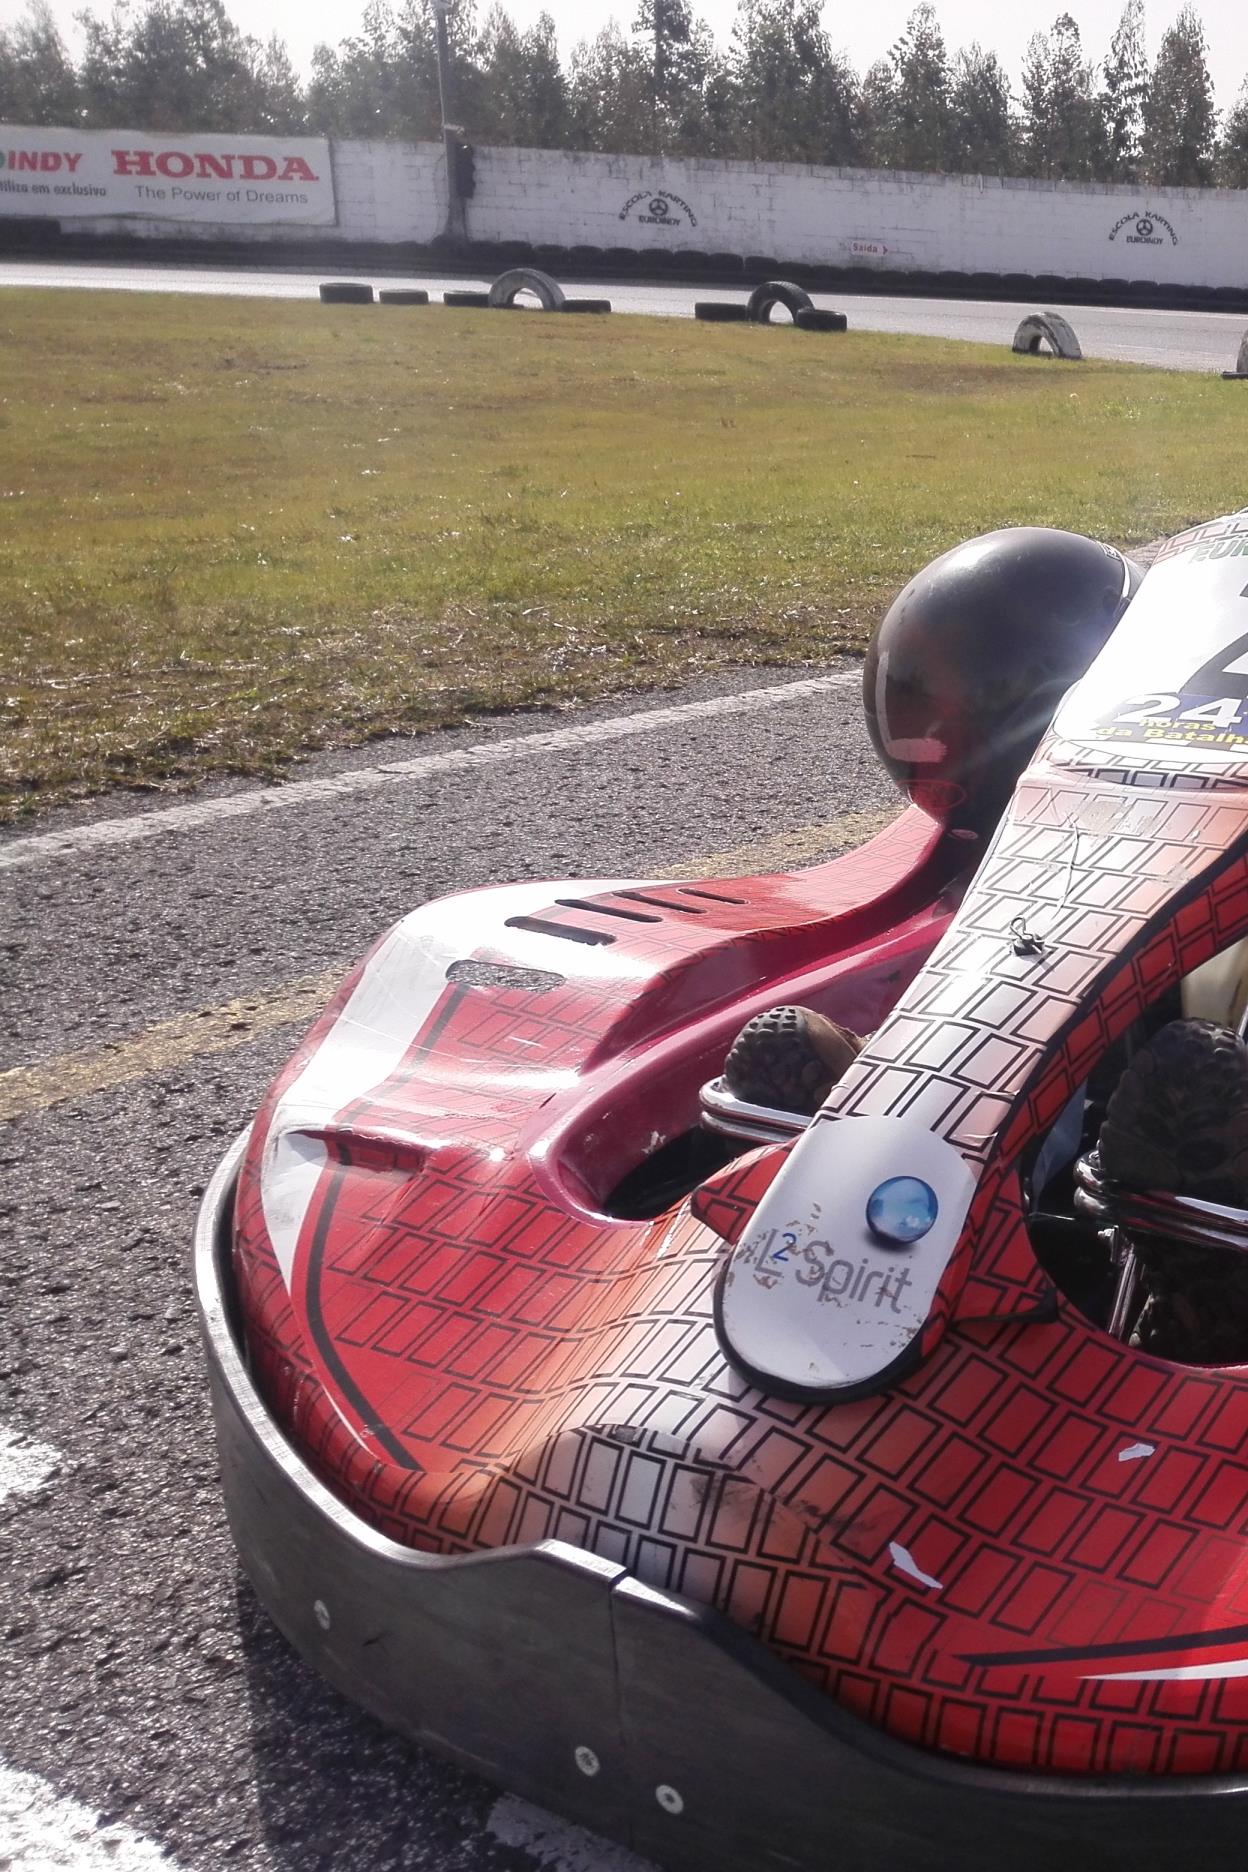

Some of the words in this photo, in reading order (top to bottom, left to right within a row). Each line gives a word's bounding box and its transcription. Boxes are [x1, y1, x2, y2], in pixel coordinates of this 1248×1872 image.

[0, 150, 83, 172] INDY
[111, 150, 319, 182] HONDA
[32, 184, 50, 194] em
[53, 182, 107, 197] exclusivo
[135, 185, 166, 200] The
[172, 188, 220, 202] Power
[226, 189, 241, 202] of
[246, 190, 309, 204] Dreams
[619, 190, 652, 220] ESCOLA
[658, 190, 698, 227] KARTING
[1109, 212, 1140, 241] ESCOLA
[1145, 210, 1178, 246] KARTING
[1111, 693, 1244, 730] 24
[1095, 725, 1133, 737] da
[1138, 718, 1217, 732] horas
